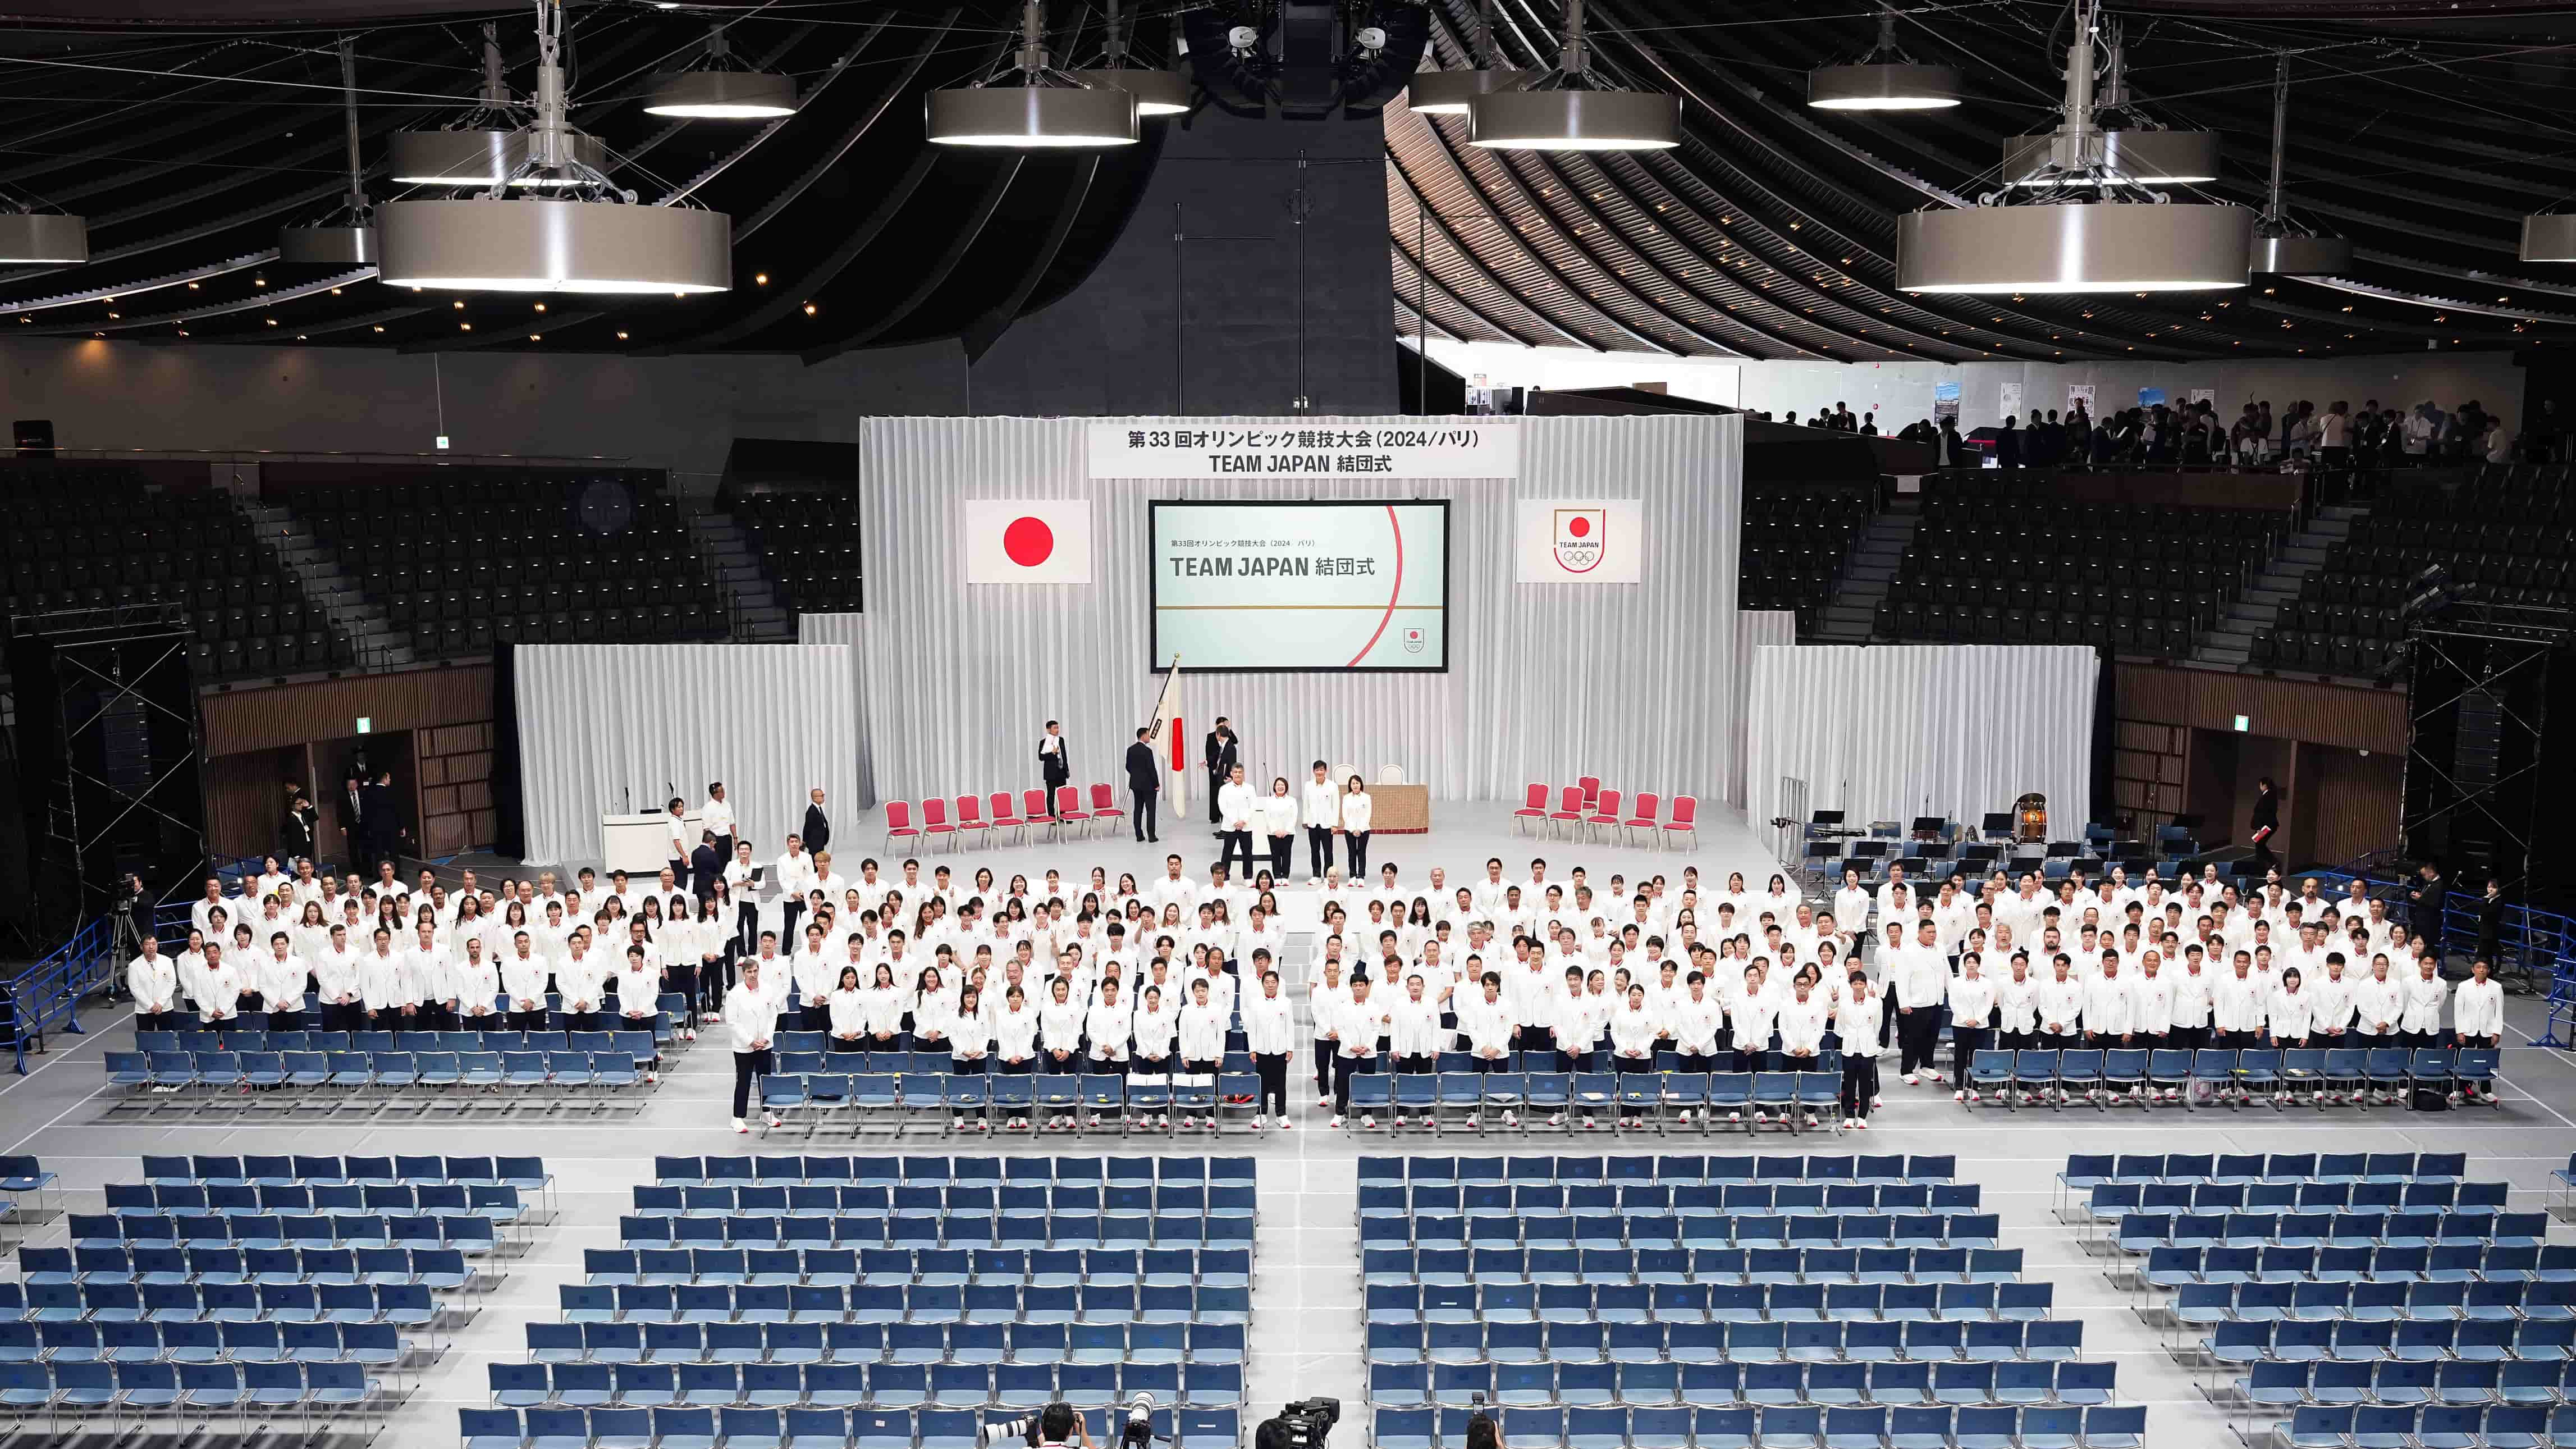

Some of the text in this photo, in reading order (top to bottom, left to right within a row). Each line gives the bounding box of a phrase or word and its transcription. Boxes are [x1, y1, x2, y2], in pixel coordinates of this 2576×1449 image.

[1209, 454, 1392, 473] TEAM JAPAN 結団式
[1169, 556, 1375, 577] TEAM JAPAN 結団式
